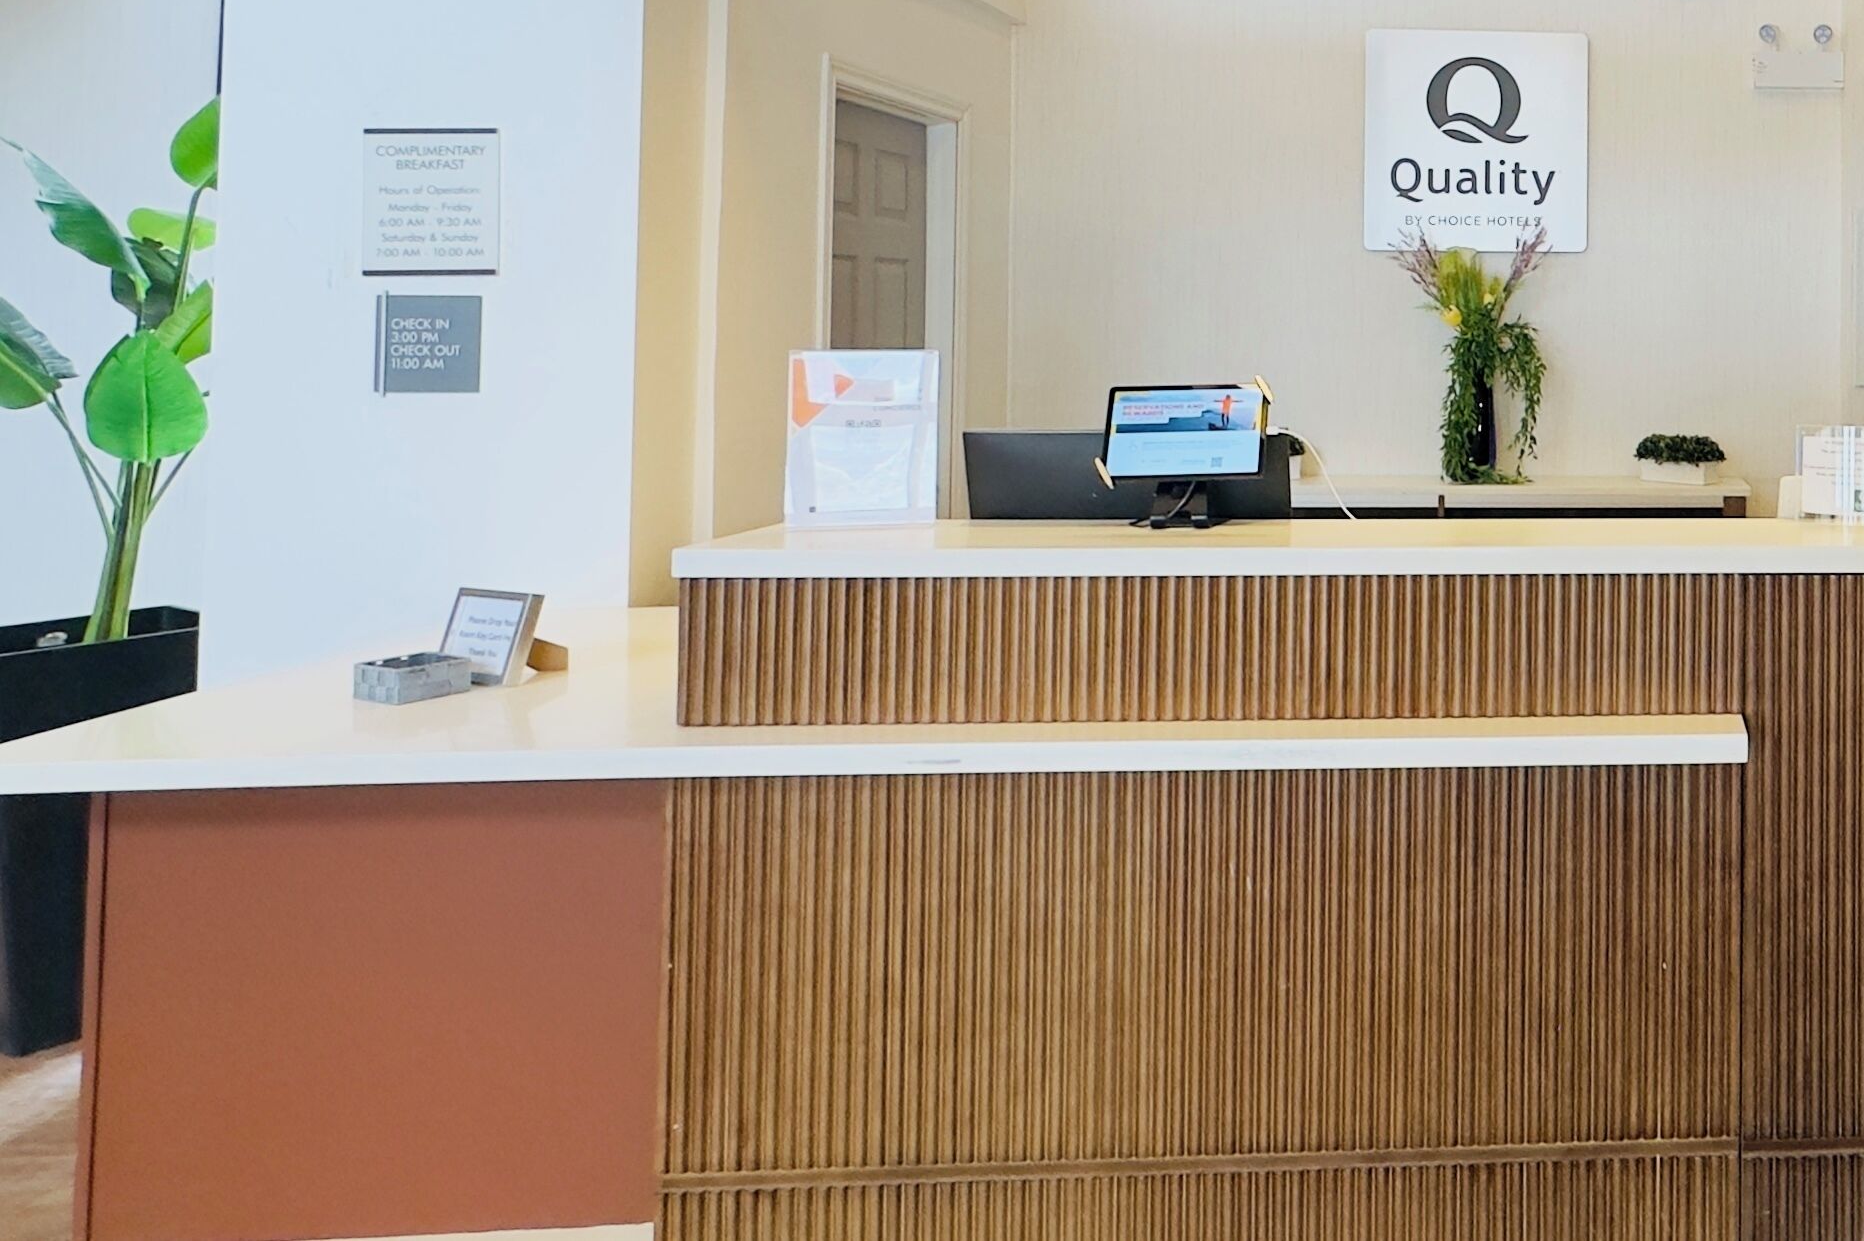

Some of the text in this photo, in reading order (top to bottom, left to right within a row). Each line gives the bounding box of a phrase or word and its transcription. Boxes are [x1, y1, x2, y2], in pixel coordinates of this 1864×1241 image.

[376, 145, 487, 157] COMPLIMENTARY
[395, 159, 465, 171] BREAKFAST
[1390, 157, 1556, 206] Quality
[379, 185, 410, 196] Hours
[413, 184, 424, 196] of
[387, 203, 431, 214] Monday
[441, 203, 473, 214] Friday
[406, 217, 426, 228] AM
[463, 217, 483, 228] AM
[1405, 215, 1542, 227] BY CHOICE HOTELS
[381, 232, 480, 243] Saturday & Sunday
[402, 246, 422, 257] AM
[465, 246, 486, 257] AM
[391, 318, 450, 330] CHECK IN
[391, 331, 440, 343] 3:00 PM
[390, 344, 461, 356] CHECK OUT
[391, 357, 445, 370] 11:00 AM
